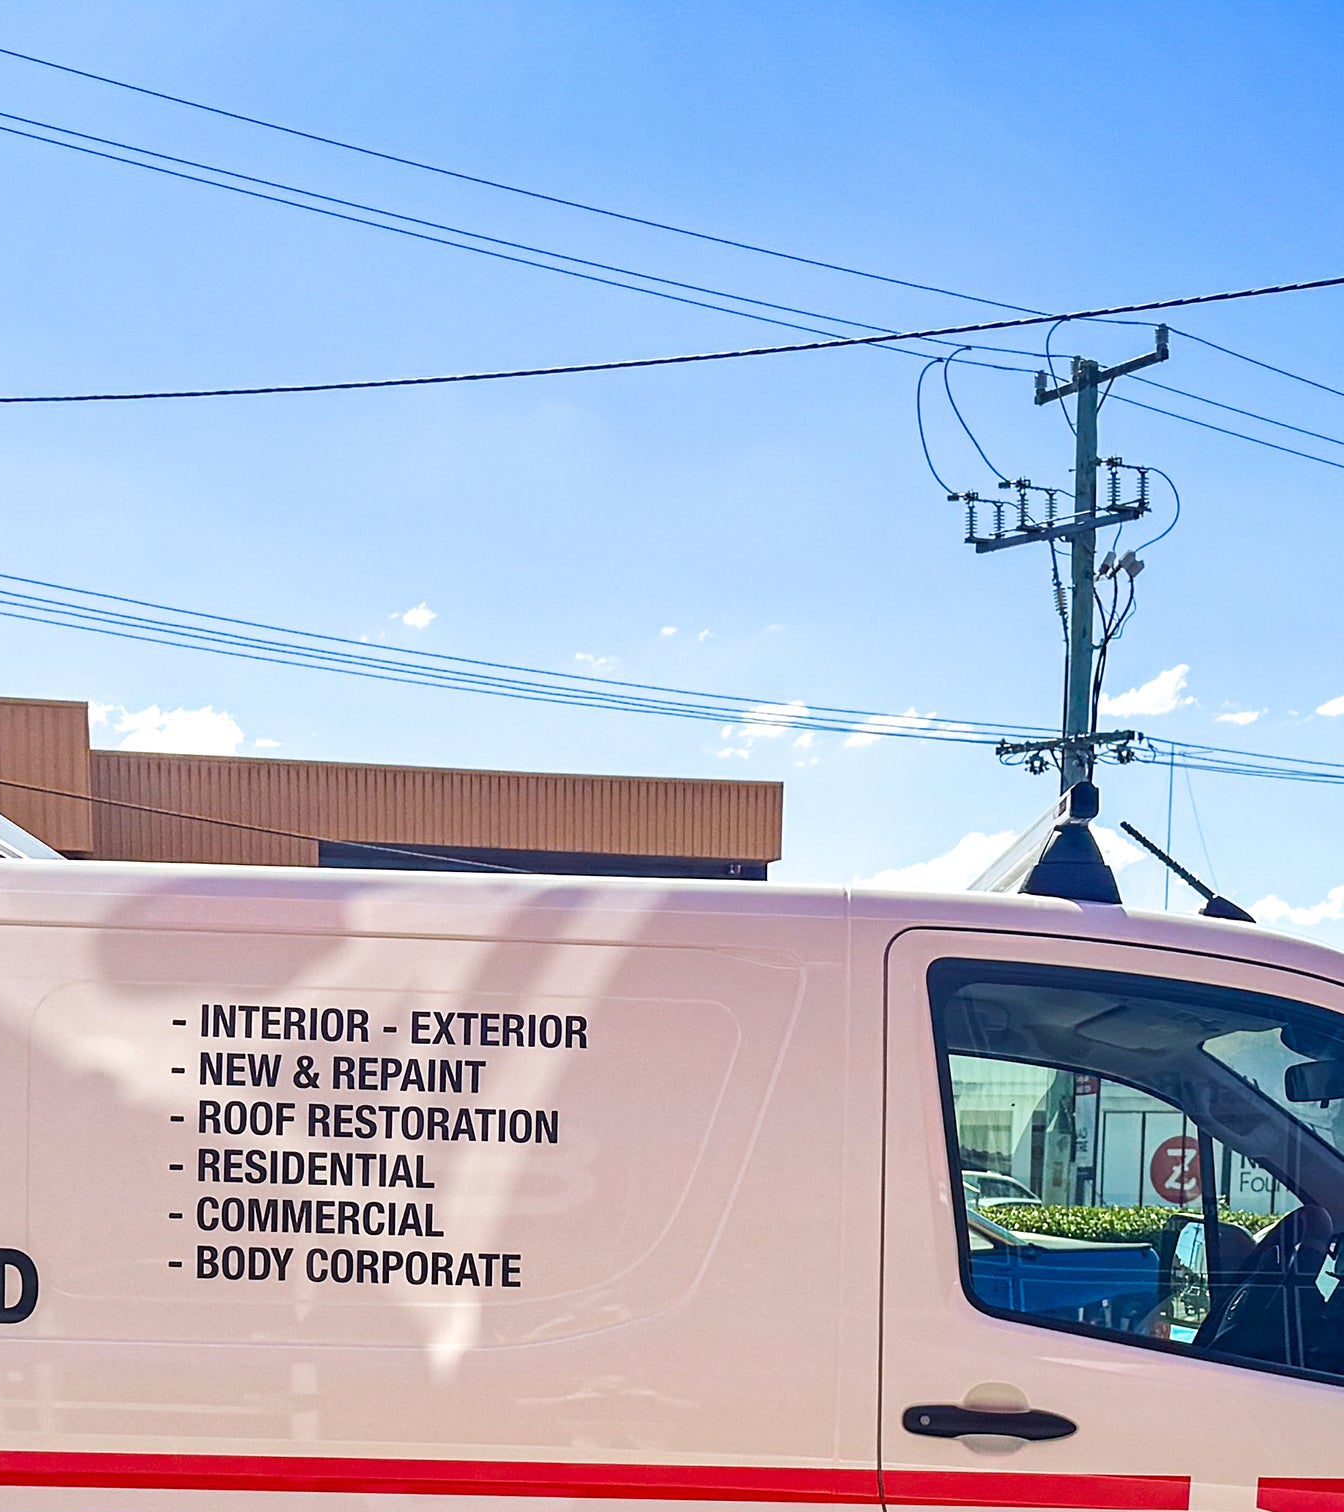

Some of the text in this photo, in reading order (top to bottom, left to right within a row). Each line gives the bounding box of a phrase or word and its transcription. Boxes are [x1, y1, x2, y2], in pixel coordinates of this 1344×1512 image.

[200, 1004, 370, 1043] INTERIOR
[411, 1011, 588, 1049] EXTERIOR
[199, 1052, 282, 1088] NEW
[293, 1056, 320, 1089] &
[332, 1056, 487, 1094] REPAINT
[199, 1100, 296, 1136] ROOF
[308, 1103, 559, 1144] RESTORATION
[197, 1149, 435, 1189] RESIDENTIAL
[196, 1197, 445, 1237] COMMERCIAL
[196, 1245, 294, 1282] BODY
[306, 1248, 522, 1288] CORPORATE
